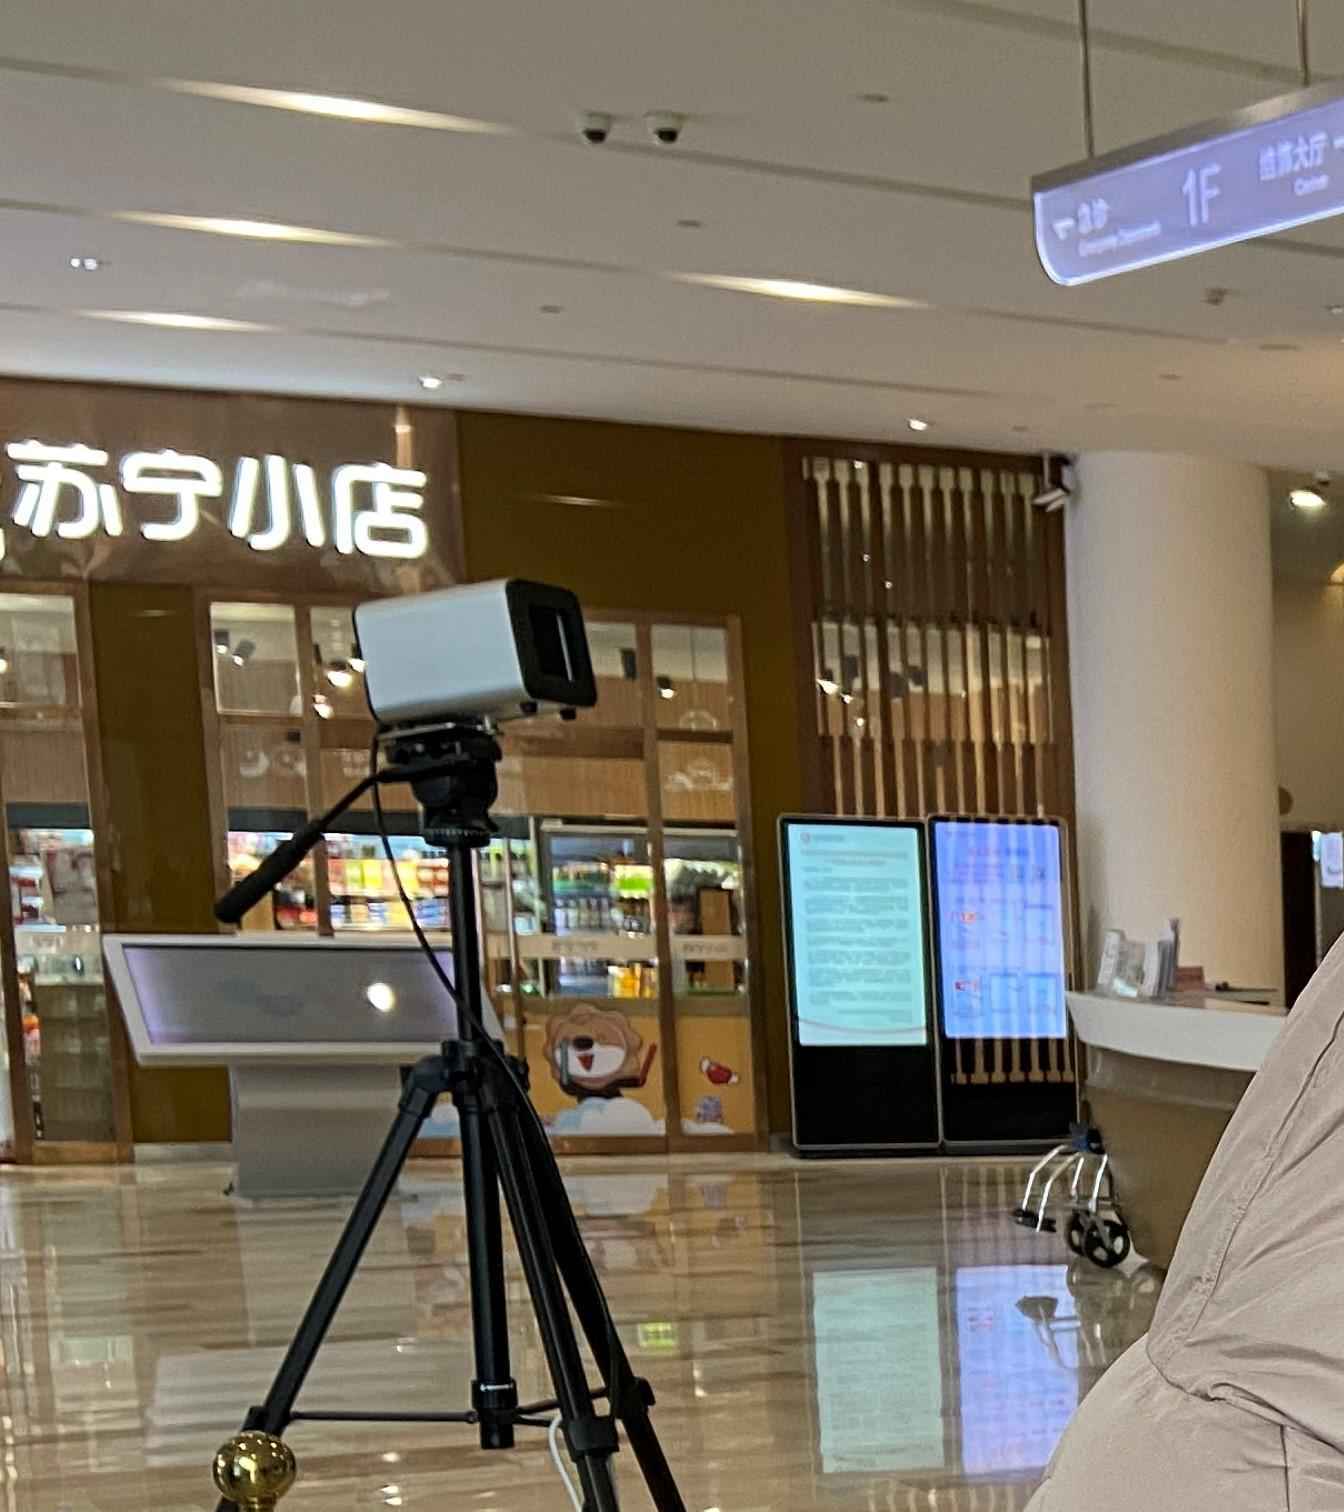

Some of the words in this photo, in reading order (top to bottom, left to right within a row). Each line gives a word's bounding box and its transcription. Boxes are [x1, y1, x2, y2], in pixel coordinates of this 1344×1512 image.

[1181, 163, 1223, 227] 1F
[5, 440, 428, 560] 苏宁小店
